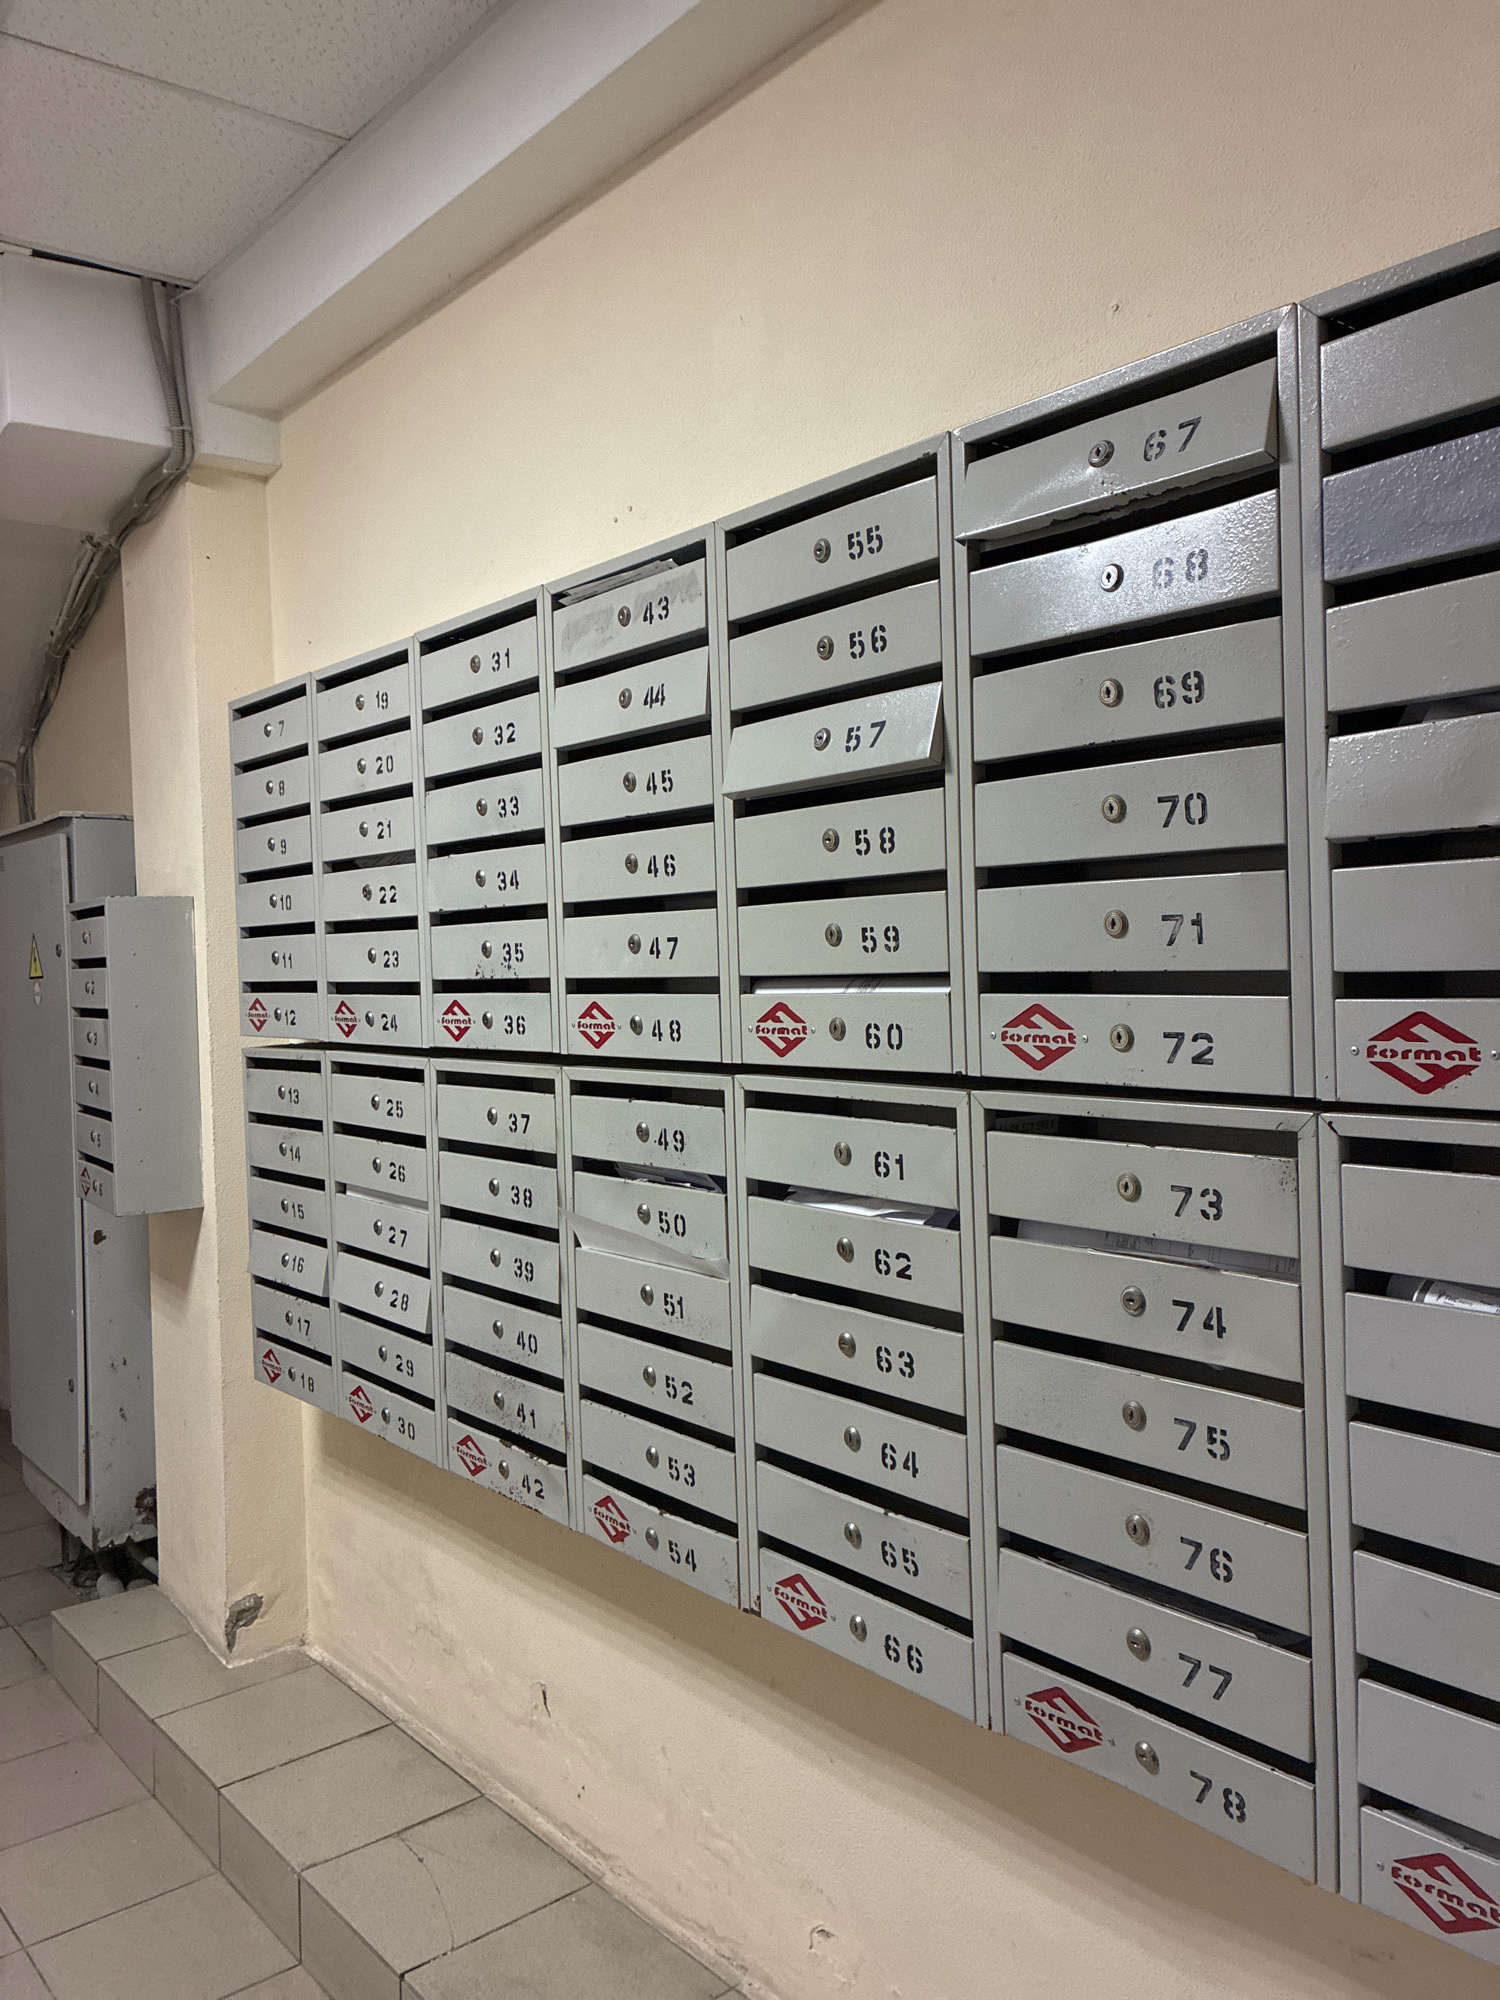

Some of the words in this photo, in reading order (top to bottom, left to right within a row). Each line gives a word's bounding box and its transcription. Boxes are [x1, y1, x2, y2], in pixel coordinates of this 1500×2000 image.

[1144, 417, 1201, 461] 67
[848, 525, 883, 560] 55
[1153, 549, 1208, 588] 68
[643, 596, 669, 624] 43
[850, 625, 887, 659] 56
[492, 648, 509, 672] 31
[375, 690, 389, 711] 19
[644, 684, 665, 709] 44
[1154, 671, 1204, 708] 69
[278, 719, 285, 737] 7
[495, 723, 515, 745] 32
[845, 720, 886, 753] 57
[375, 754, 394, 775] 20
[278, 779, 285, 797] 8
[647, 770, 673, 795] 45
[498, 796, 519, 818] 33
[1158, 793, 1207, 828] 70
[376, 820, 392, 840] 21
[855, 827, 895, 855] 58
[280, 838, 287, 855] 9
[648, 854, 675, 877] 46
[497, 870, 519, 891] 34
[279, 894, 292, 911] 10
[378, 884, 397, 905] 22
[861, 926, 899, 953] 59
[1162, 913, 1203, 946] 71
[383, 950, 400, 969] 23
[503, 943, 524, 963] 35
[650, 937, 678, 959] 47
[282, 952, 293, 970] 11
[284, 1009, 297, 1026] 12
[380, 1013, 398, 1033] 24
[441, 1016, 472, 1025] format
[504, 1015, 525, 1035] 36
[577, 1020, 616, 1031] format
[652, 1020, 681, 1042] 48
[755, 1024, 808, 1036] format
[866, 1023, 902, 1050] 60
[1000, 1029, 1077, 1046] format
[1163, 1032, 1213, 1065] 72
[1366, 1043, 1483, 1063] format
[287, 1087, 300, 1105] 13
[386, 1098, 404, 1119] 25
[509, 1113, 529, 1134] 37
[658, 1128, 684, 1152] 49
[289, 1145, 301, 1163] 14
[875, 1151, 903, 1180] 61
[389, 1161, 406, 1183] 26
[511, 1185, 532, 1208] 38
[1171, 1185, 1222, 1221] 73
[291, 1201, 305, 1220] 15
[659, 1211, 686, 1237] 50
[388, 1225, 408, 1248] 27
[292, 1255, 305, 1274] 16
[514, 1258, 533, 1282] 39
[875, 1249, 912, 1280] 62
[389, 1289, 410, 1313] 28
[664, 1293, 683, 1319] 51
[297, 1316, 311, 1336] 17
[1172, 1300, 1226, 1338] 74
[517, 1331, 537, 1354] 40
[395, 1353, 414, 1378] 29
[876, 1346, 914, 1378] 63
[300, 1372, 315, 1393] 18
[666, 1375, 693, 1405] 52
[517, 1403, 536, 1429] 41
[397, 1416, 416, 1441] 30
[1174, 1418, 1230, 1460] 75
[456, 1446, 488, 1466] format
[882, 1443, 918, 1478] 64
[668, 1457, 695, 1487] 53
[522, 1475, 544, 1499] 42
[593, 1506, 631, 1532] format
[669, 1540, 696, 1572] 54
[882, 1541, 919, 1577] 65
[1180, 1536, 1233, 1583] 76
[774, 1587, 828, 1619] format
[884, 1635, 923, 1673] 66
[1179, 1653, 1232, 1700] 77
[1025, 1699, 1103, 1742] format
[1190, 1770, 1246, 1823] 78
